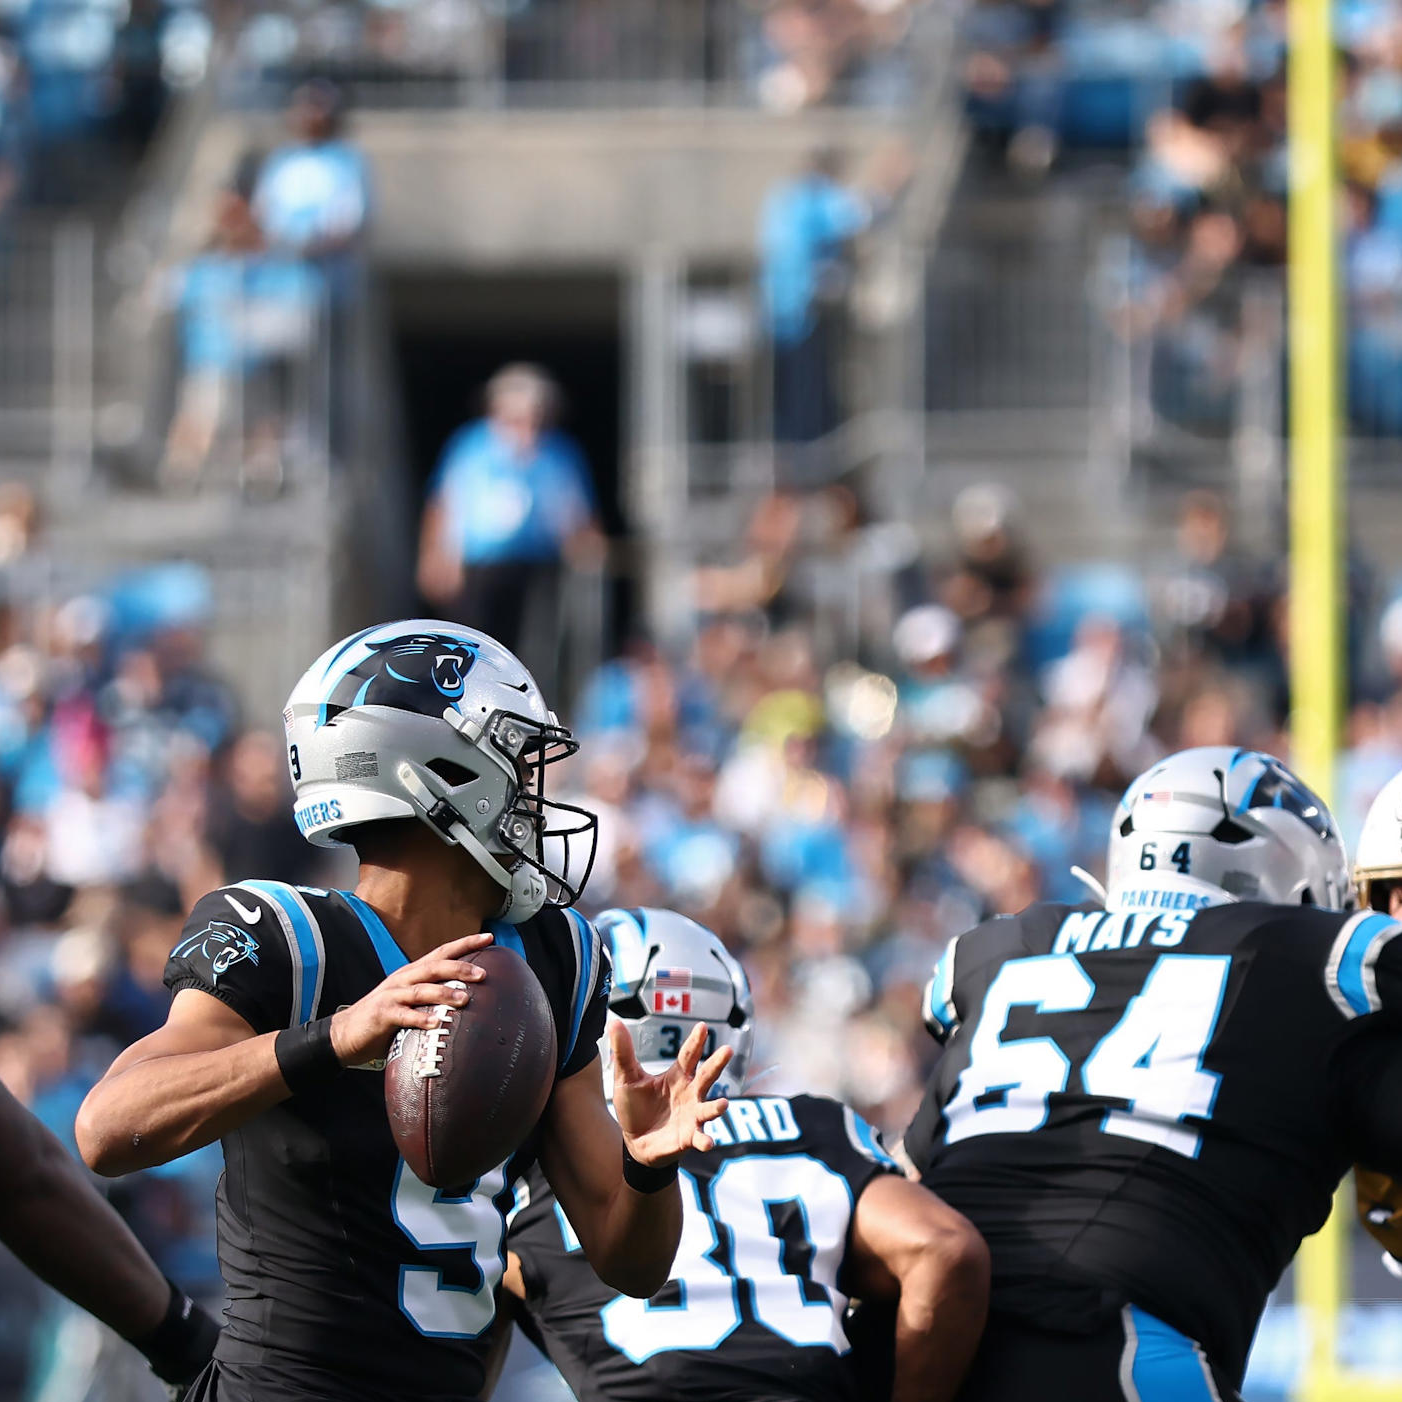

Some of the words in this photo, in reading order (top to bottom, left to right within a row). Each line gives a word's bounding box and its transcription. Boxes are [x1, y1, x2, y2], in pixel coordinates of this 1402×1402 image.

[1139, 842, 1191, 874] 64
[1120, 889, 1212, 912] PANTHERS
[1050, 908, 1200, 955] MAYS
[942, 952, 1234, 1160] 64
[390, 1151, 516, 1341] 9
